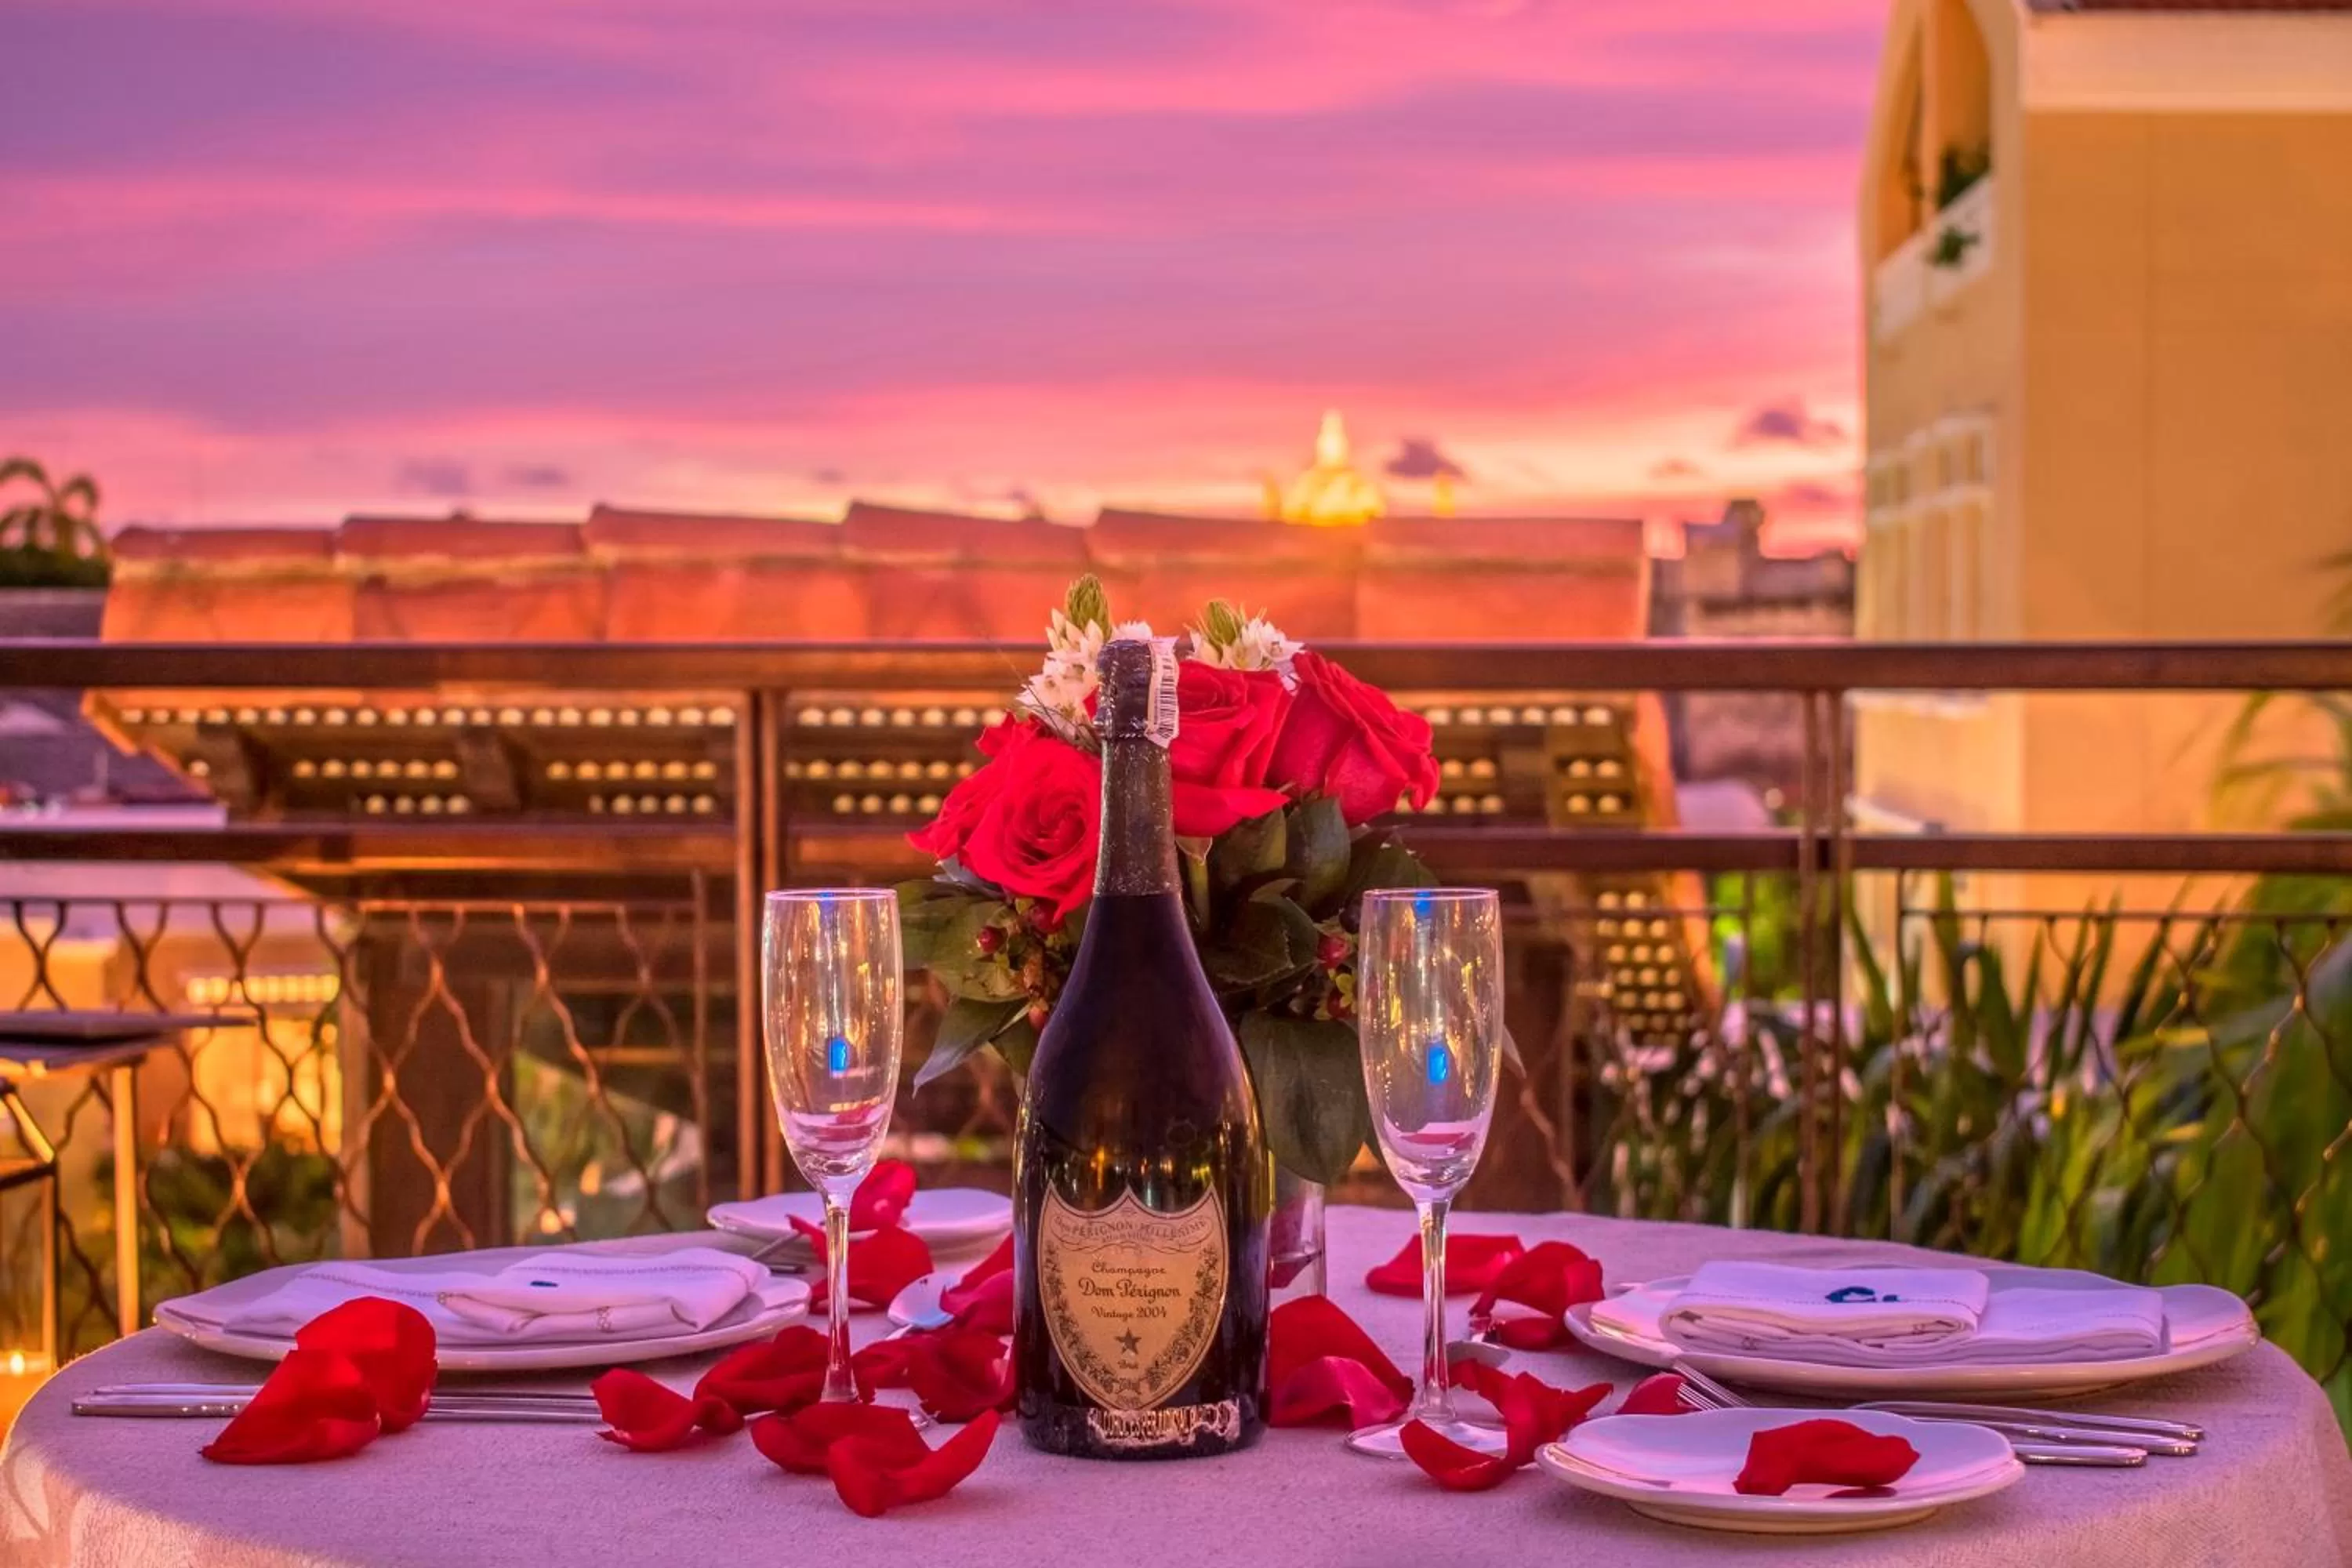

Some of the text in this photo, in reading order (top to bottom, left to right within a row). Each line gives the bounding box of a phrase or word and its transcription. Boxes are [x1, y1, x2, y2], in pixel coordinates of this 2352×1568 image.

[1091, 1261, 1167, 1278] Champagne
[1078, 1276, 1181, 1304] Dom Pérignon
[1091, 1305, 1167, 1322] Vintage 2004
